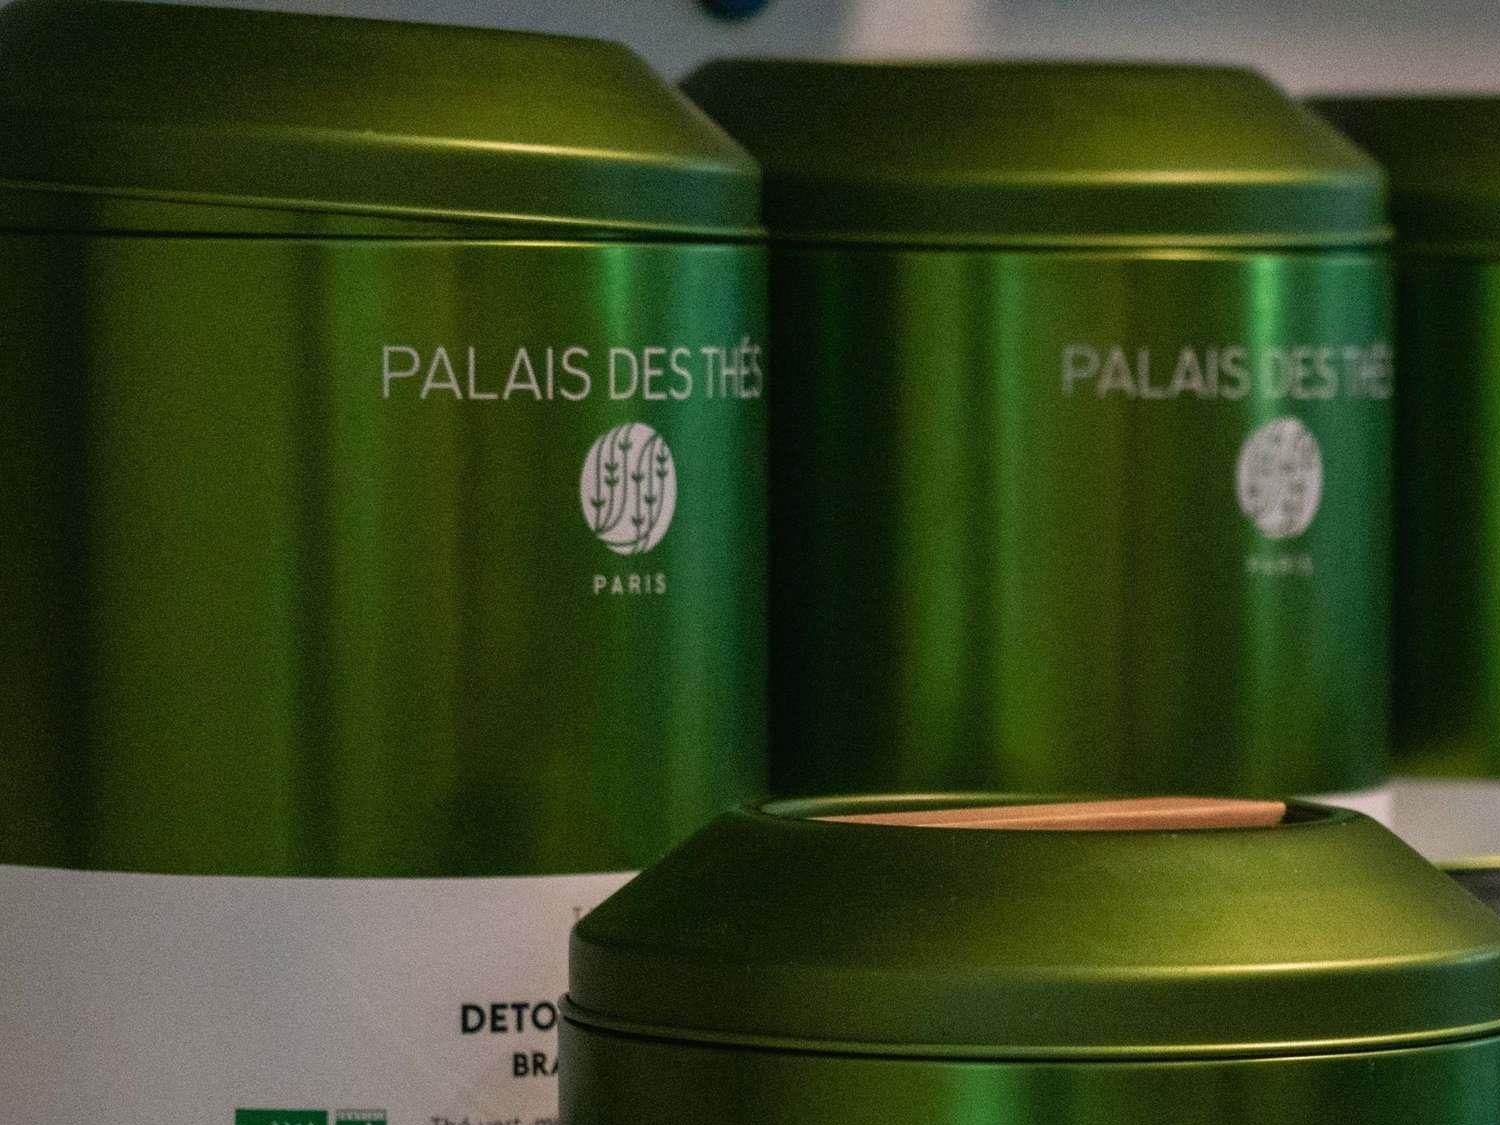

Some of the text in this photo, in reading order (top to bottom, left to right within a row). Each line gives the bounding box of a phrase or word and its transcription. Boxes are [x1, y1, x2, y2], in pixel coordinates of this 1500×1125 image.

[381, 345, 592, 400] PALAIS
[608, 346, 694, 400] DES
[1060, 343, 1250, 400] PALAIS
[593, 573, 667, 595] PARIS
